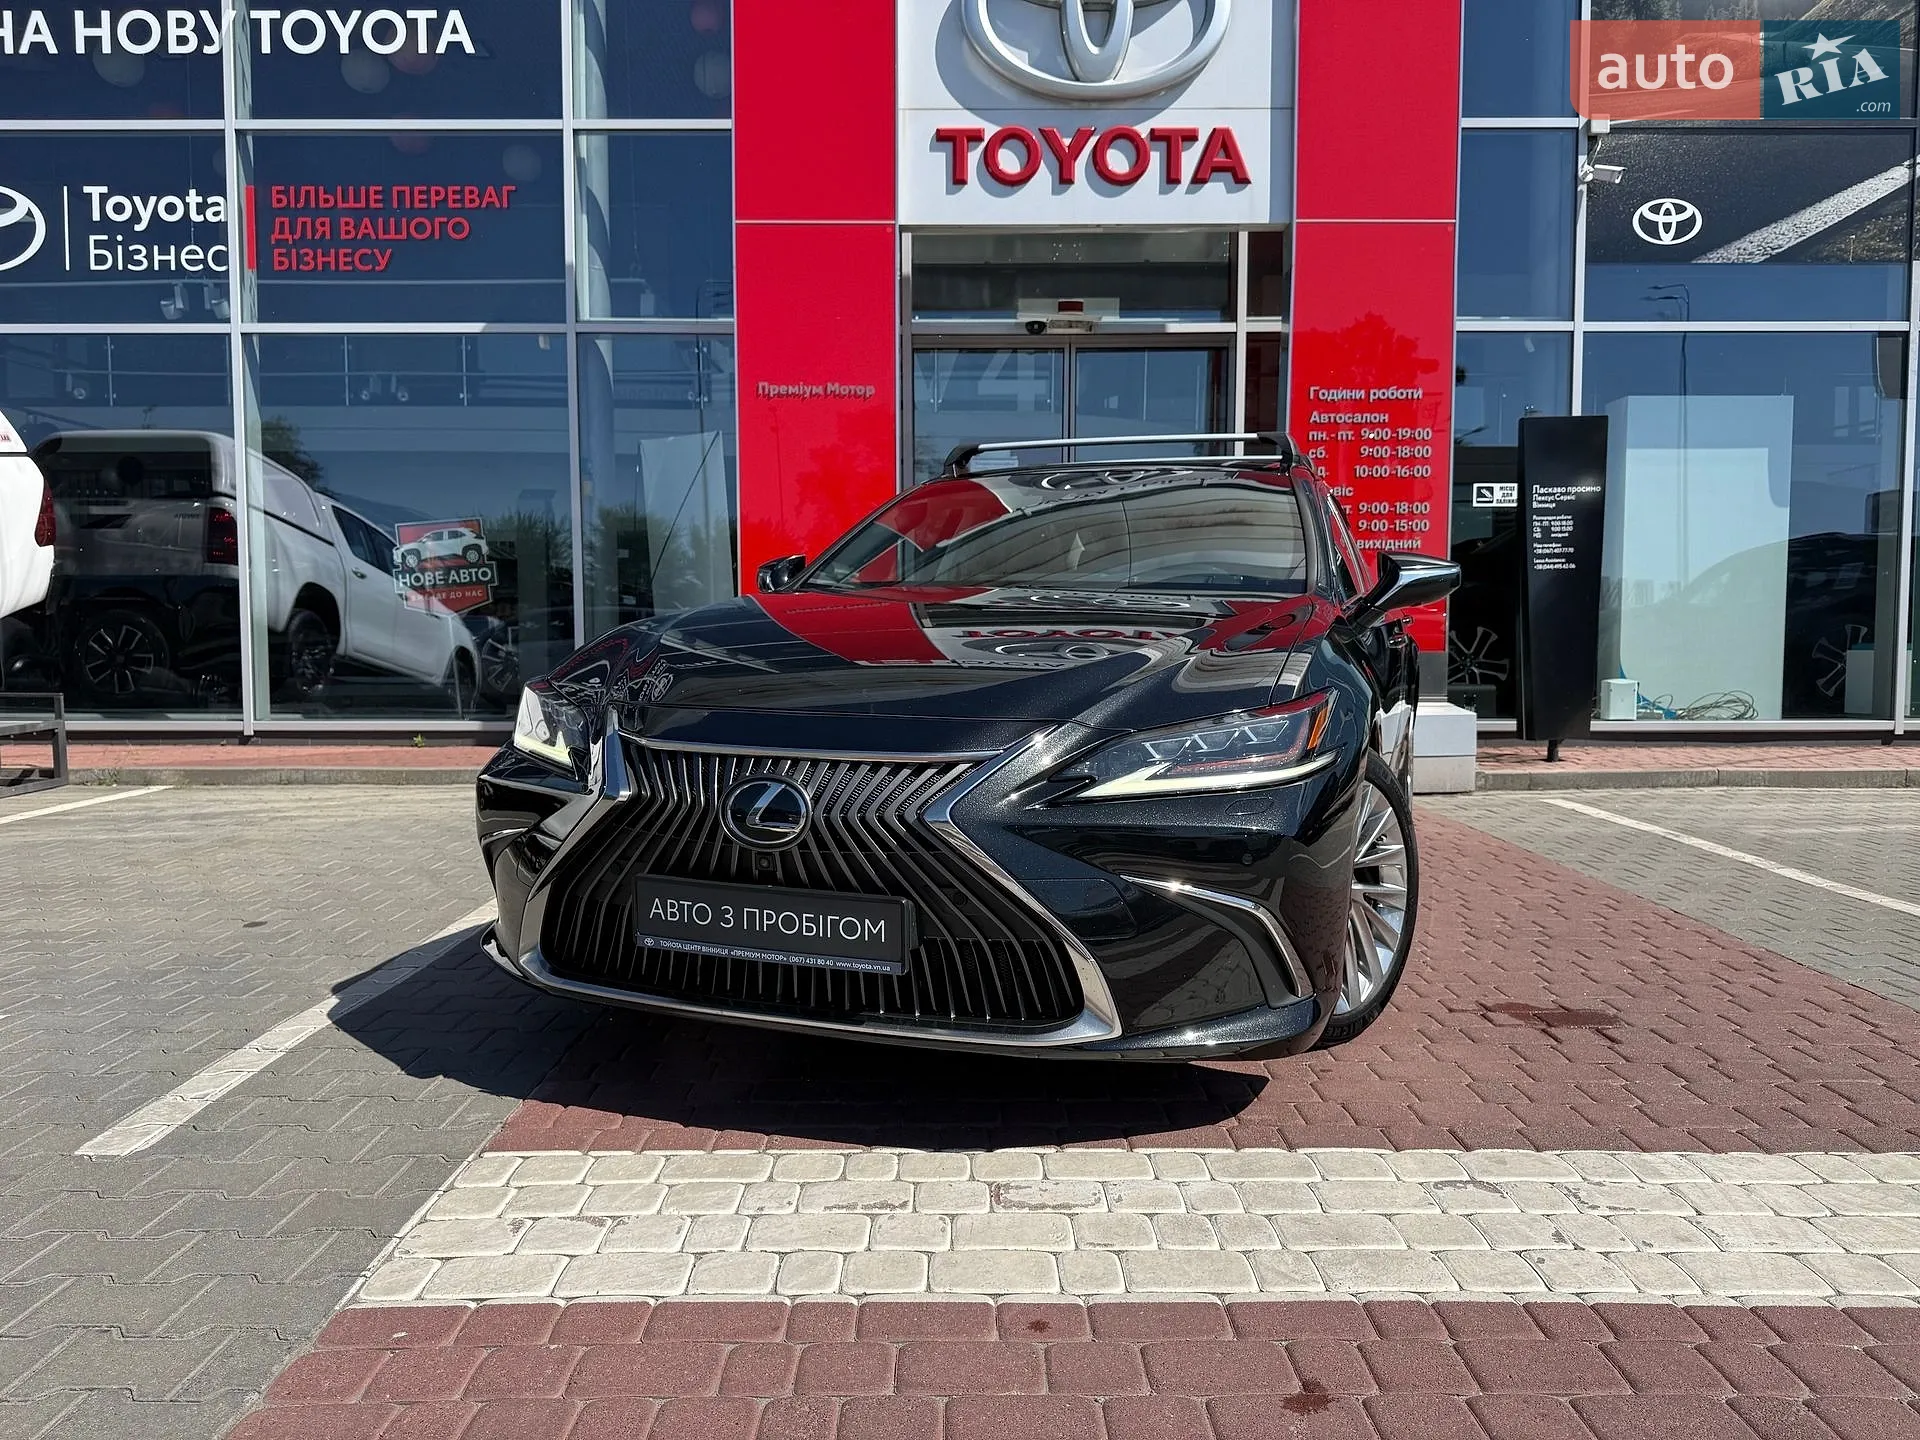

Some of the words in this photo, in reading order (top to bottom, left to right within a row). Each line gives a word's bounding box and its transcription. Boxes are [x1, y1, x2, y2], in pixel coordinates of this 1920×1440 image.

[74, 9, 236, 55] НОВУ
[250, 9, 476, 55] TOYOTA
[936, 125, 1252, 186] TOYOTA
[271, 185, 384, 209] БІЛЬШЕ
[392, 185, 516, 209] ПЕРЕВАГ
[83, 185, 227, 231] Toyota
[271, 217, 331, 244] ДЛЯ
[340, 217, 470, 241] ВАШОГО
[89, 235, 229, 272] Бізнес
[273, 248, 392, 272] БІЗНЕСУ
[757, 381, 823, 398] Преміум
[826, 382, 876, 398] Мотор
[1309, 386, 1365, 400] Години
[1370, 385, 1423, 402] роботи
[1309, 411, 1389, 424] Автосалон
[1360, 428, 1432, 441] 9:00-19:00
[1308, 446, 1328, 459] сб.
[1360, 445, 1432, 459] 9:00-18:00
[1317, 467, 1330, 479] д.
[1354, 465, 1432, 478] 10:00-16:00
[1532, 484, 1566, 494] Ласкаво
[1567, 486, 1602, 495] просимо
[1358, 502, 1430, 515] 9:00-18:00
[1358, 519, 1430, 532] 9:00-15:00
[1356, 536, 1422, 551] вихідний
[399, 571, 445, 587] НОВЕ
[448, 567, 492, 584] АВТО
[649, 897, 712, 926] АВТО
[743, 907, 886, 943] ПРОБІГОМ
[659, 940, 683, 950] ТОЙОТА
[683, 943, 702, 952] ЦЕНТР
[701, 946, 729, 956] ВІННИЦЯ
[789, 955, 805, 965] (067)
[825, 959, 834, 967] 40
[835, 961, 891, 973] www.toyota.vn.ua
